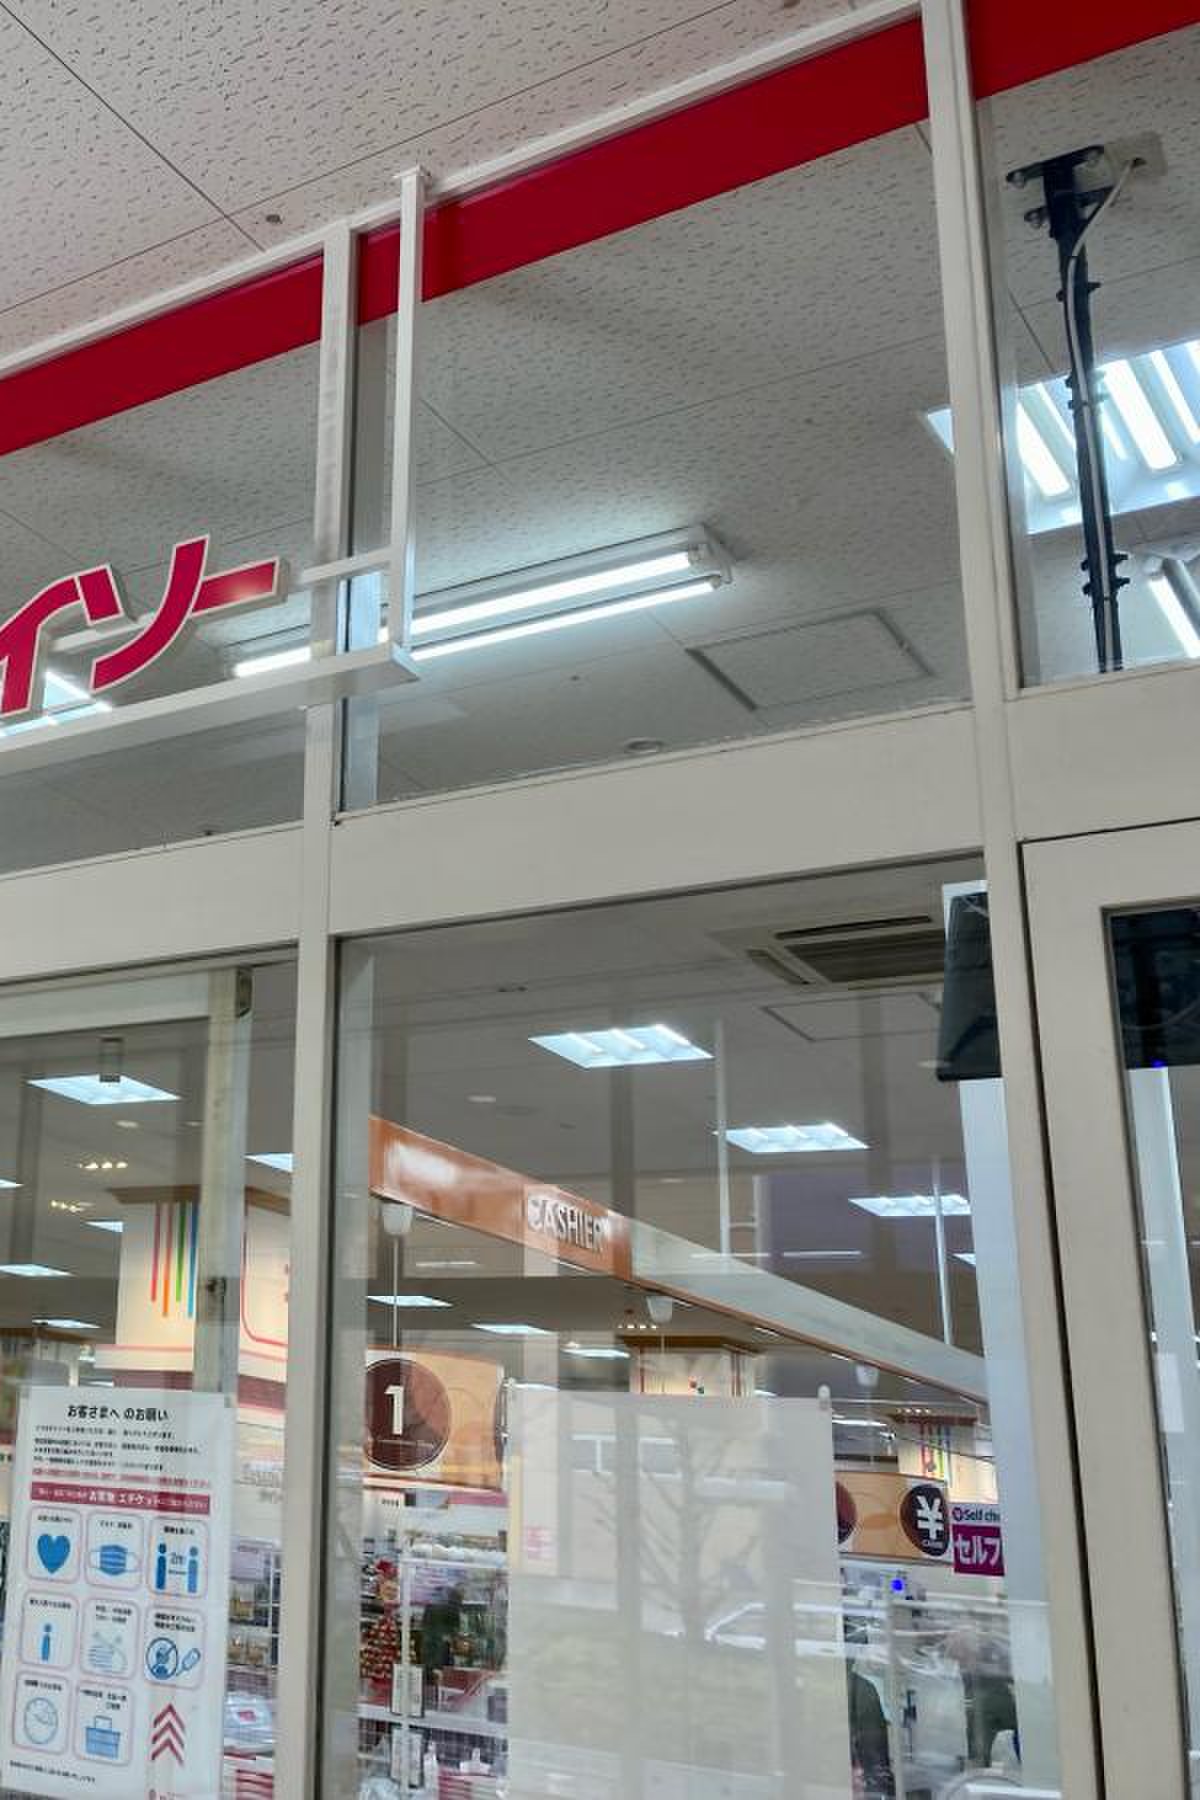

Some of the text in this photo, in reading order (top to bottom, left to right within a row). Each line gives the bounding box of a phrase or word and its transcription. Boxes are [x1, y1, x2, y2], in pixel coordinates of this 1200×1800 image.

[527, 1197, 608, 1254] CASHIER
[384, 1385, 405, 1436] 1
[954, 1533, 1001, 1567] セルフ
